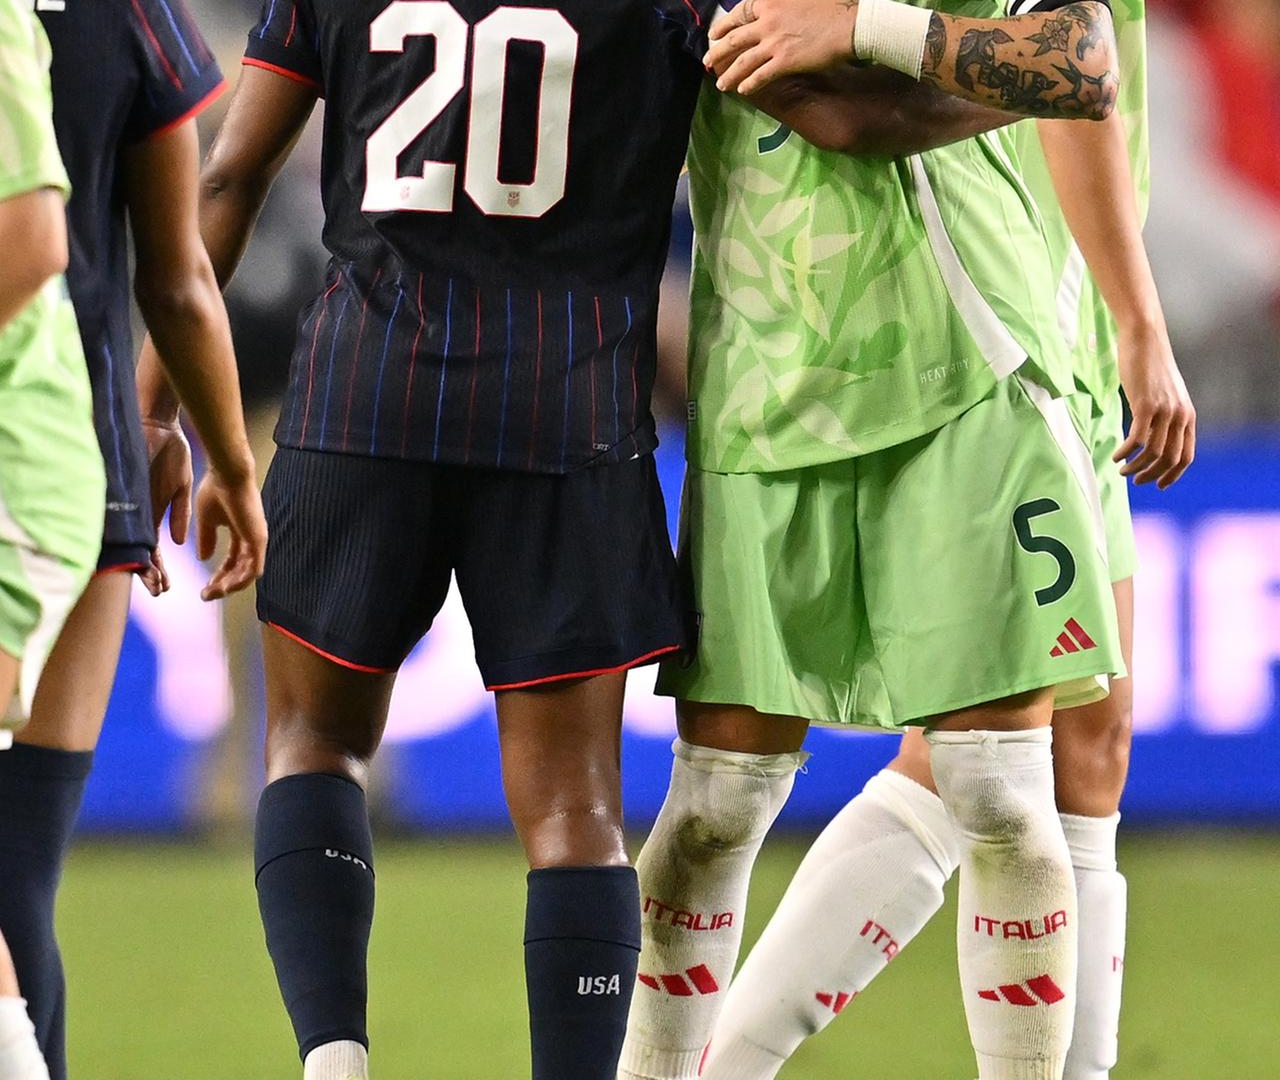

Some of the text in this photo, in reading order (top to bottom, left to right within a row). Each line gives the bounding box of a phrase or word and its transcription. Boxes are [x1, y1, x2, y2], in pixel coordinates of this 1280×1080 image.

[361, 0, 579, 218] 20
[1012, 497, 1076, 607] 5
[644, 897, 733, 931] ITALIA
[974, 910, 1067, 940] ITALIA
[577, 974, 620, 995] USA
